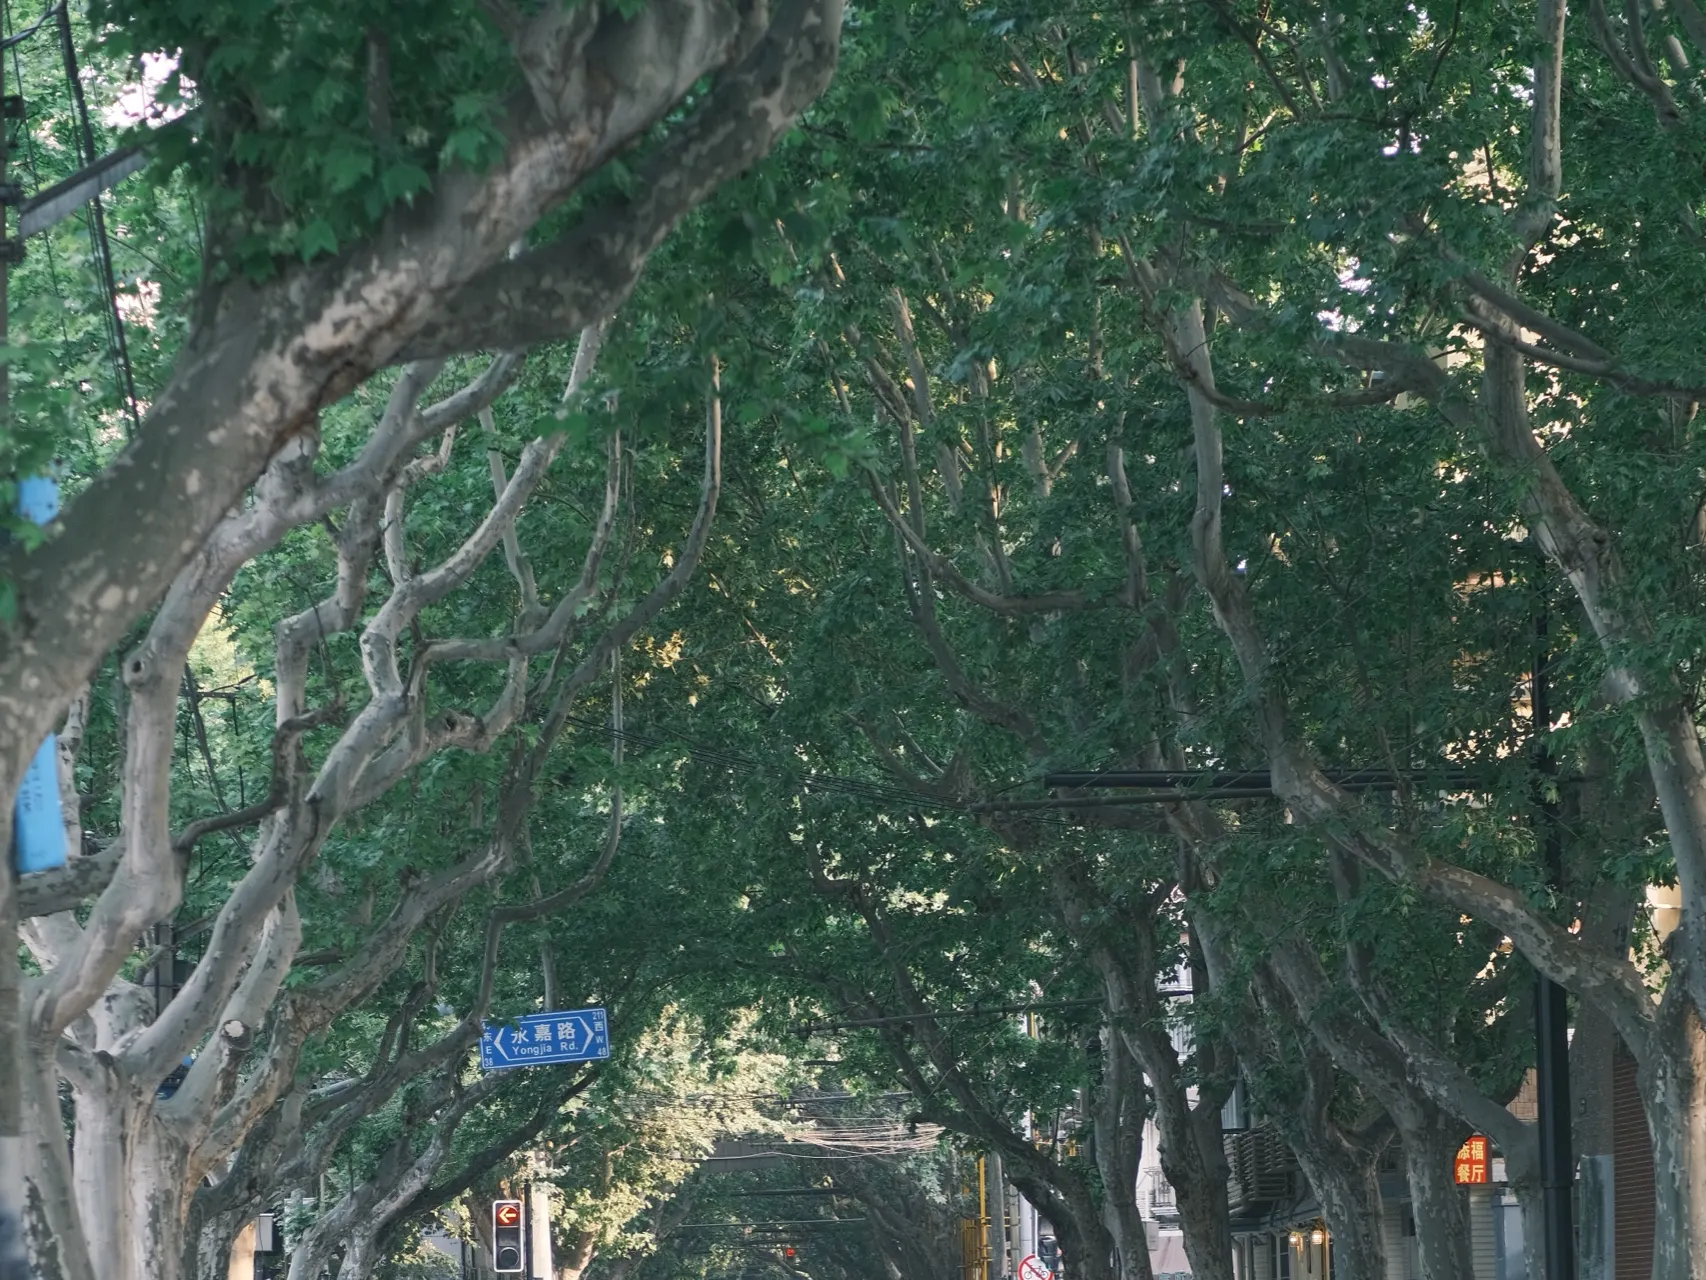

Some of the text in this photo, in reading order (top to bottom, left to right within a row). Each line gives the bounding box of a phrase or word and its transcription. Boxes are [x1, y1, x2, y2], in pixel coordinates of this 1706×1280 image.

[592, 1011, 604, 1020] 211
[594, 1021, 604, 1032] 西
[483, 1032, 493, 1042] 东
[510, 1022, 576, 1044] 永嘉路
[595, 1035, 605, 1044] W
[485, 1045, 493, 1055] E
[512, 1041, 579, 1056] Yongjia Rd.
[1457, 1163, 1484, 1183] 餐厅
